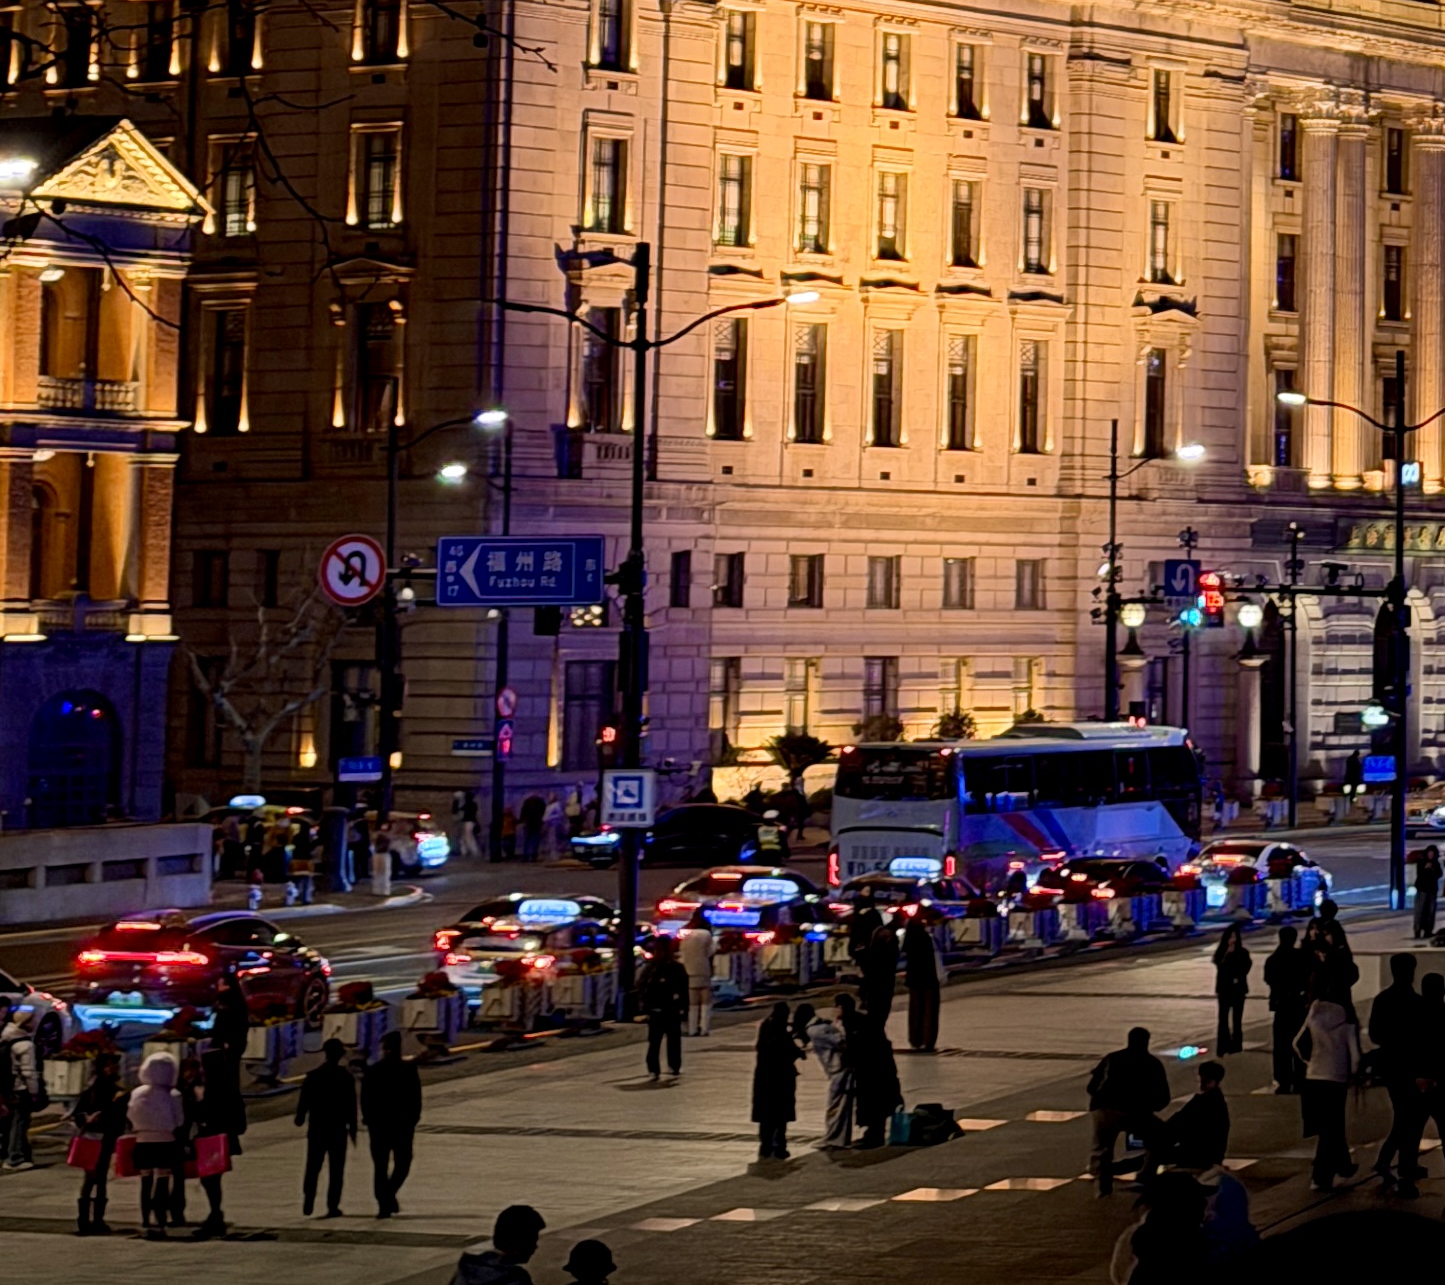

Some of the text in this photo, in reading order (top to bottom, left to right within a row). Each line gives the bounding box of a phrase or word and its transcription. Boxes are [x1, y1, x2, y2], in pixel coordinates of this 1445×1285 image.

[486, 551, 563, 572] 福州路
[489, 575, 558, 588] Fuzhou Rd
